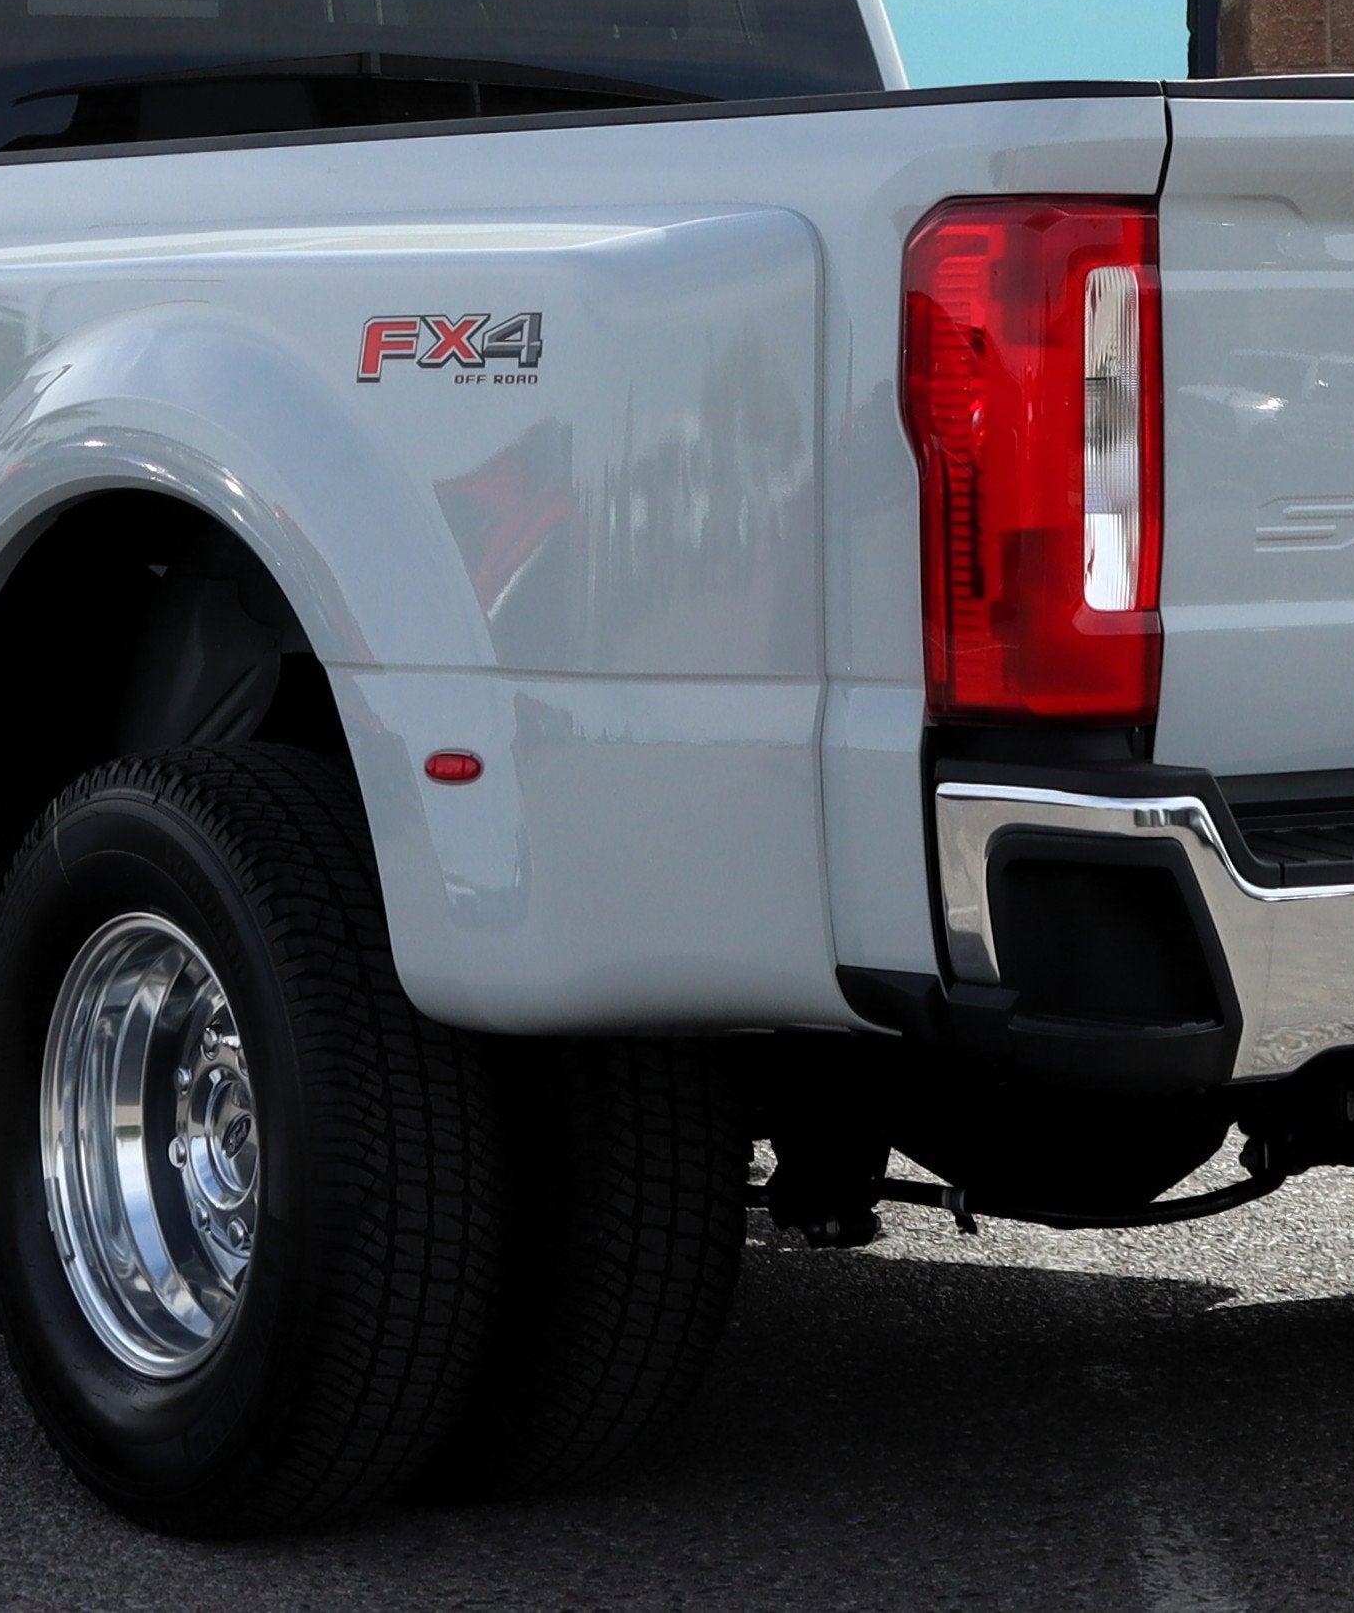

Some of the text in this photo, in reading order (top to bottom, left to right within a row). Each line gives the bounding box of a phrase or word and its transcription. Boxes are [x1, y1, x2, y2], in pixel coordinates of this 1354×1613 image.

[356, 312, 543, 383] FX4
[454, 374, 539, 385] OFF ROAD
